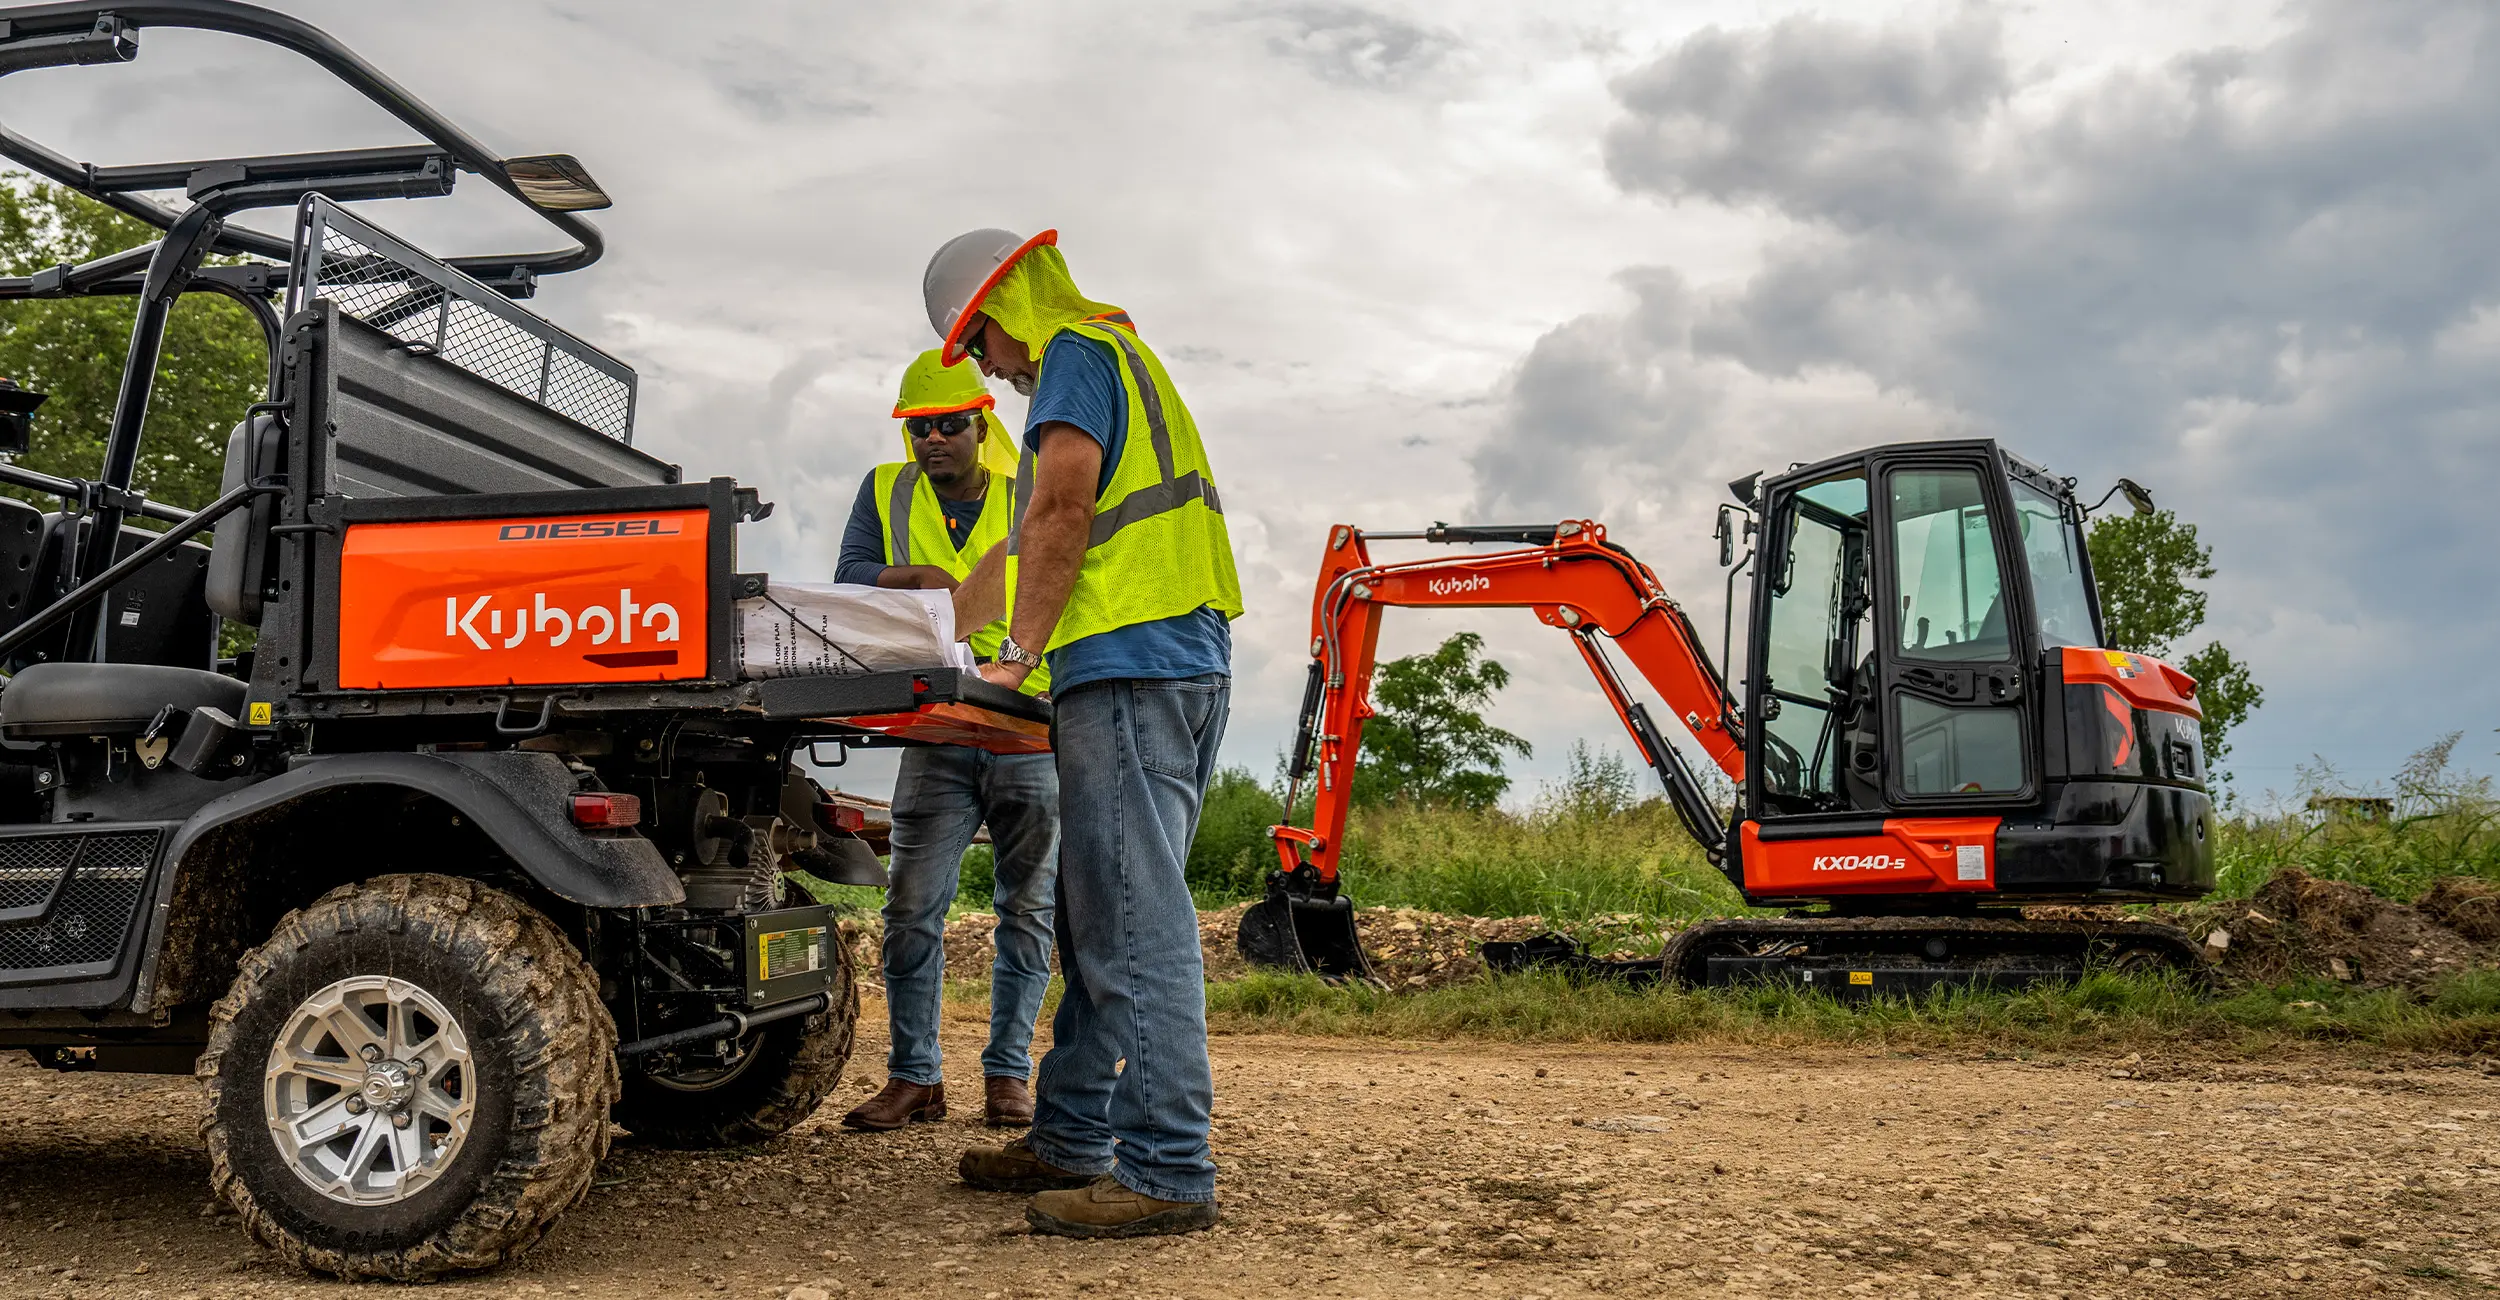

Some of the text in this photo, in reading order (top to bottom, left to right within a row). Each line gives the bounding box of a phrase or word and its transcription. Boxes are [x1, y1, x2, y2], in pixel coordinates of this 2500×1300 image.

[499, 520, 680, 541] DIESEL
[1429, 574, 1490, 595] Kubota
[446, 588, 680, 651] Kubota
[1813, 855, 1905, 871] KX040-5
